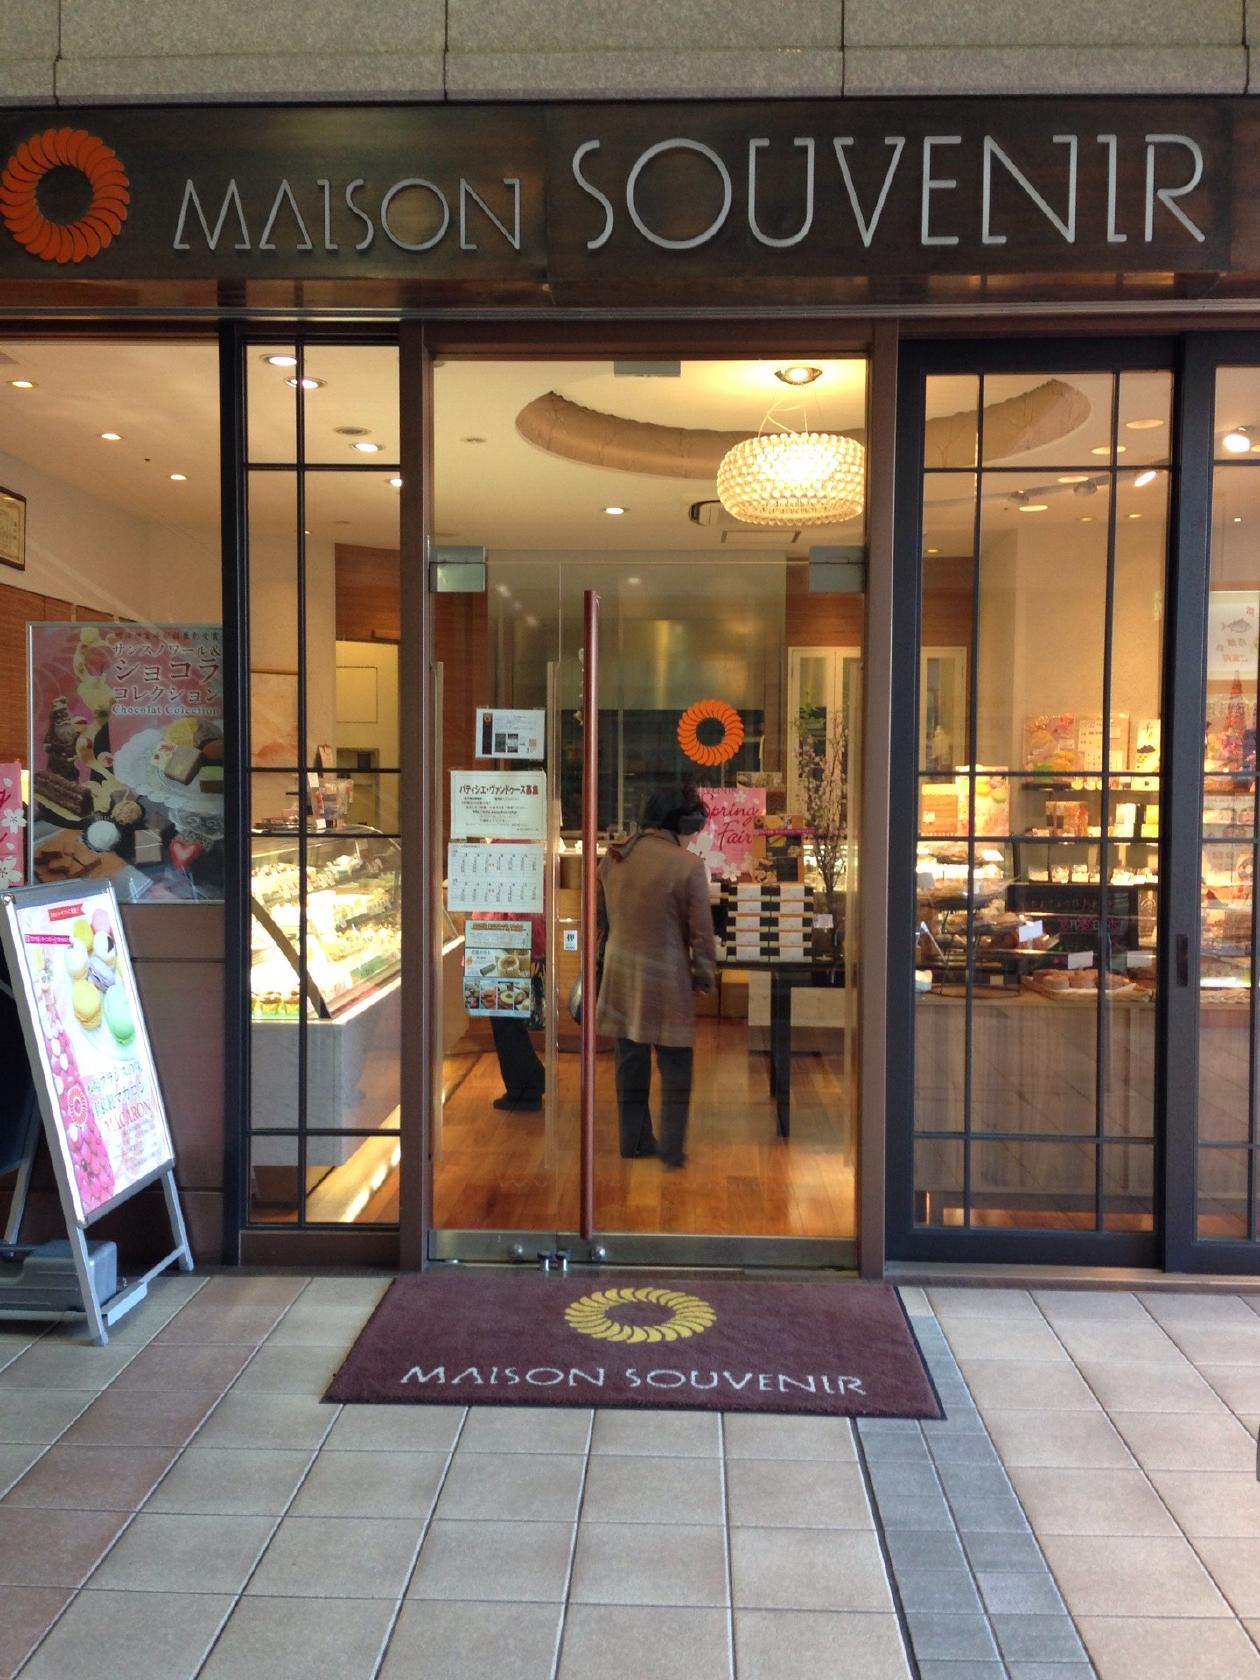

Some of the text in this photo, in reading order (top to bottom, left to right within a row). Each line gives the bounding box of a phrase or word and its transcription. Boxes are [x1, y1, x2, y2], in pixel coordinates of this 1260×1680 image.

[172, 134, 1206, 252] MAISON SOUVENIR
[115, 657, 219, 684] ショコラ
[112, 704, 160, 715] Chocolat
[114, 685, 218, 703] コレクション
[702, 791, 760, 827] Spring
[717, 819, 753, 850] Fair
[400, 1365, 867, 1397] MAISON SOUVENIR
